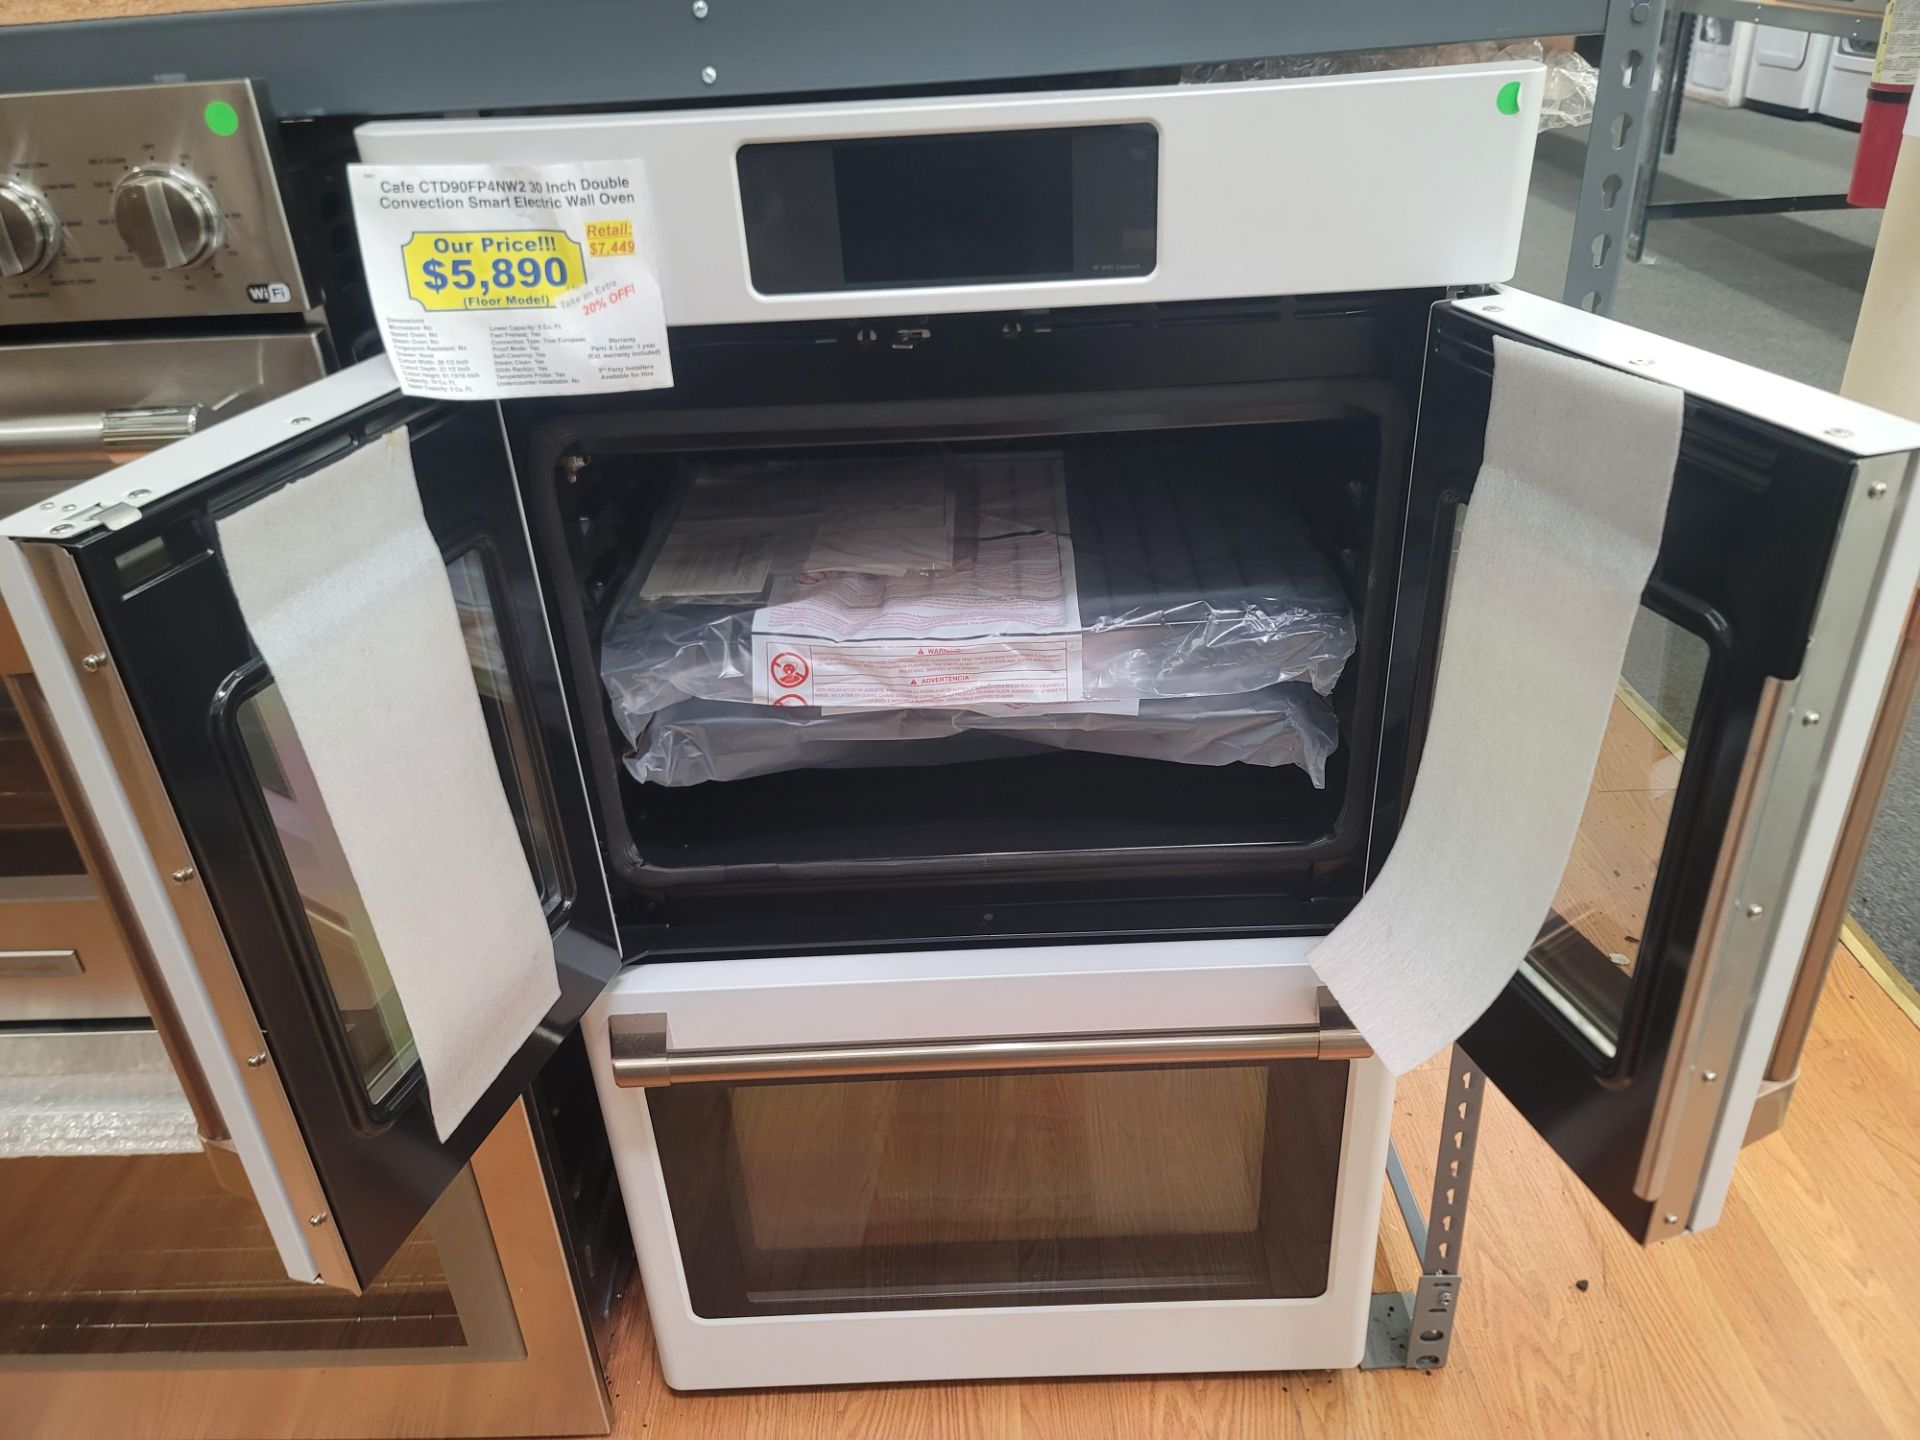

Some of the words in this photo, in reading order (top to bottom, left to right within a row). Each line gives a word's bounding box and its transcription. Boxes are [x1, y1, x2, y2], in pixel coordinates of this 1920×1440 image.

[380, 180, 414, 194] Cafe
[419, 180, 527, 194] CTD90FP4NW2
[530, 181, 543, 194] 30
[546, 179, 576, 194] Inch
[580, 177, 630, 192] Double
[380, 196, 464, 210] Convection
[468, 195, 511, 209] Smart
[514, 195, 562, 210] Electric
[565, 194, 595, 208] Wall
[599, 192, 635, 206] Oven
[586, 222, 633, 238] Retail:
[434, 238, 473, 254] Our
[481, 236, 557, 253] Price!!!
[589, 240, 636, 257] $7,449
[421, 256, 568, 296] $5,890
[463, 296, 503, 310] (Floor
[506, 294, 550, 308] Model)
[560, 296, 581, 310] Take
[583, 291, 594, 301] an
[594, 280, 618, 295] Extra
[582, 297, 608, 316] 20%
[609, 284, 637, 304] OFF!
[921, 675, 970, 684] ADVERTENCIA
